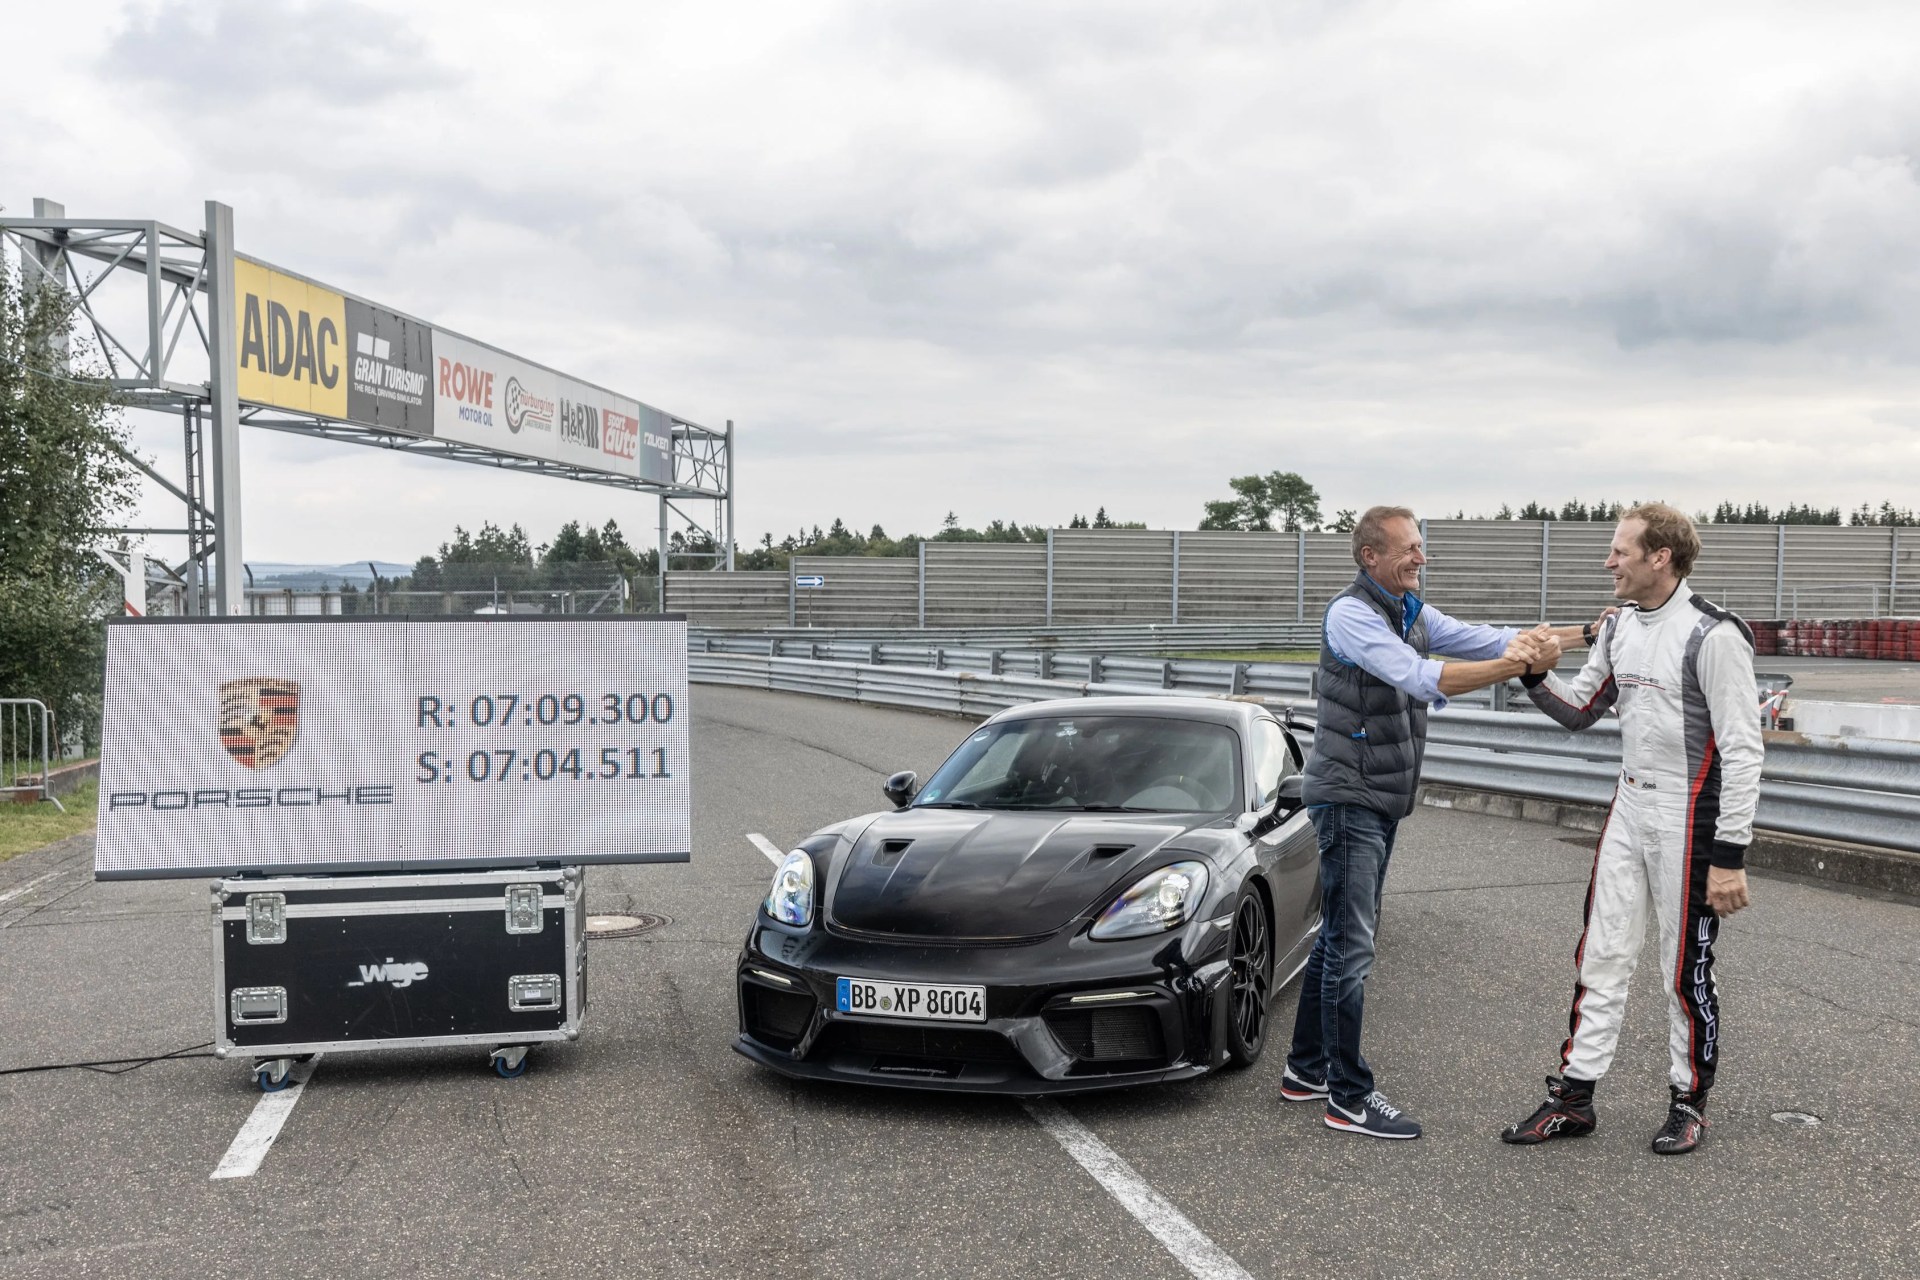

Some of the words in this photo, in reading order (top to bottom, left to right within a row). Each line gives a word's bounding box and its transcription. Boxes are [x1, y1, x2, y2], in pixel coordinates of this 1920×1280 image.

[240, 292, 339, 390] ADAC
[354, 357, 383, 386] GRAN
[384, 364, 425, 397] TURISMO
[354, 382, 364, 393] THE
[364, 385, 377, 396] REAL
[377, 388, 397, 400] DRIVING
[396, 392, 423, 406] SIMULATOR
[438, 356, 494, 409] ROWE
[459, 406, 483, 425] MOTOR
[483, 412, 493, 427] OIL
[560, 397, 586, 447] H&R
[604, 428, 638, 457] auto
[643, 431, 669, 452] FALKEN
[417, 695, 456, 728] R:
[471, 692, 674, 728] 07:09.300
[416, 750, 452, 784] S:
[466, 746, 673, 783] 07:04.511
[108, 785, 394, 812] PORSCHE
[1641, 781, 1657, 790] JÖRG
[851, 984, 877, 1009] BB
[894, 987, 920, 1013] XP
[926, 989, 982, 1016] 8004
[1693, 915, 1718, 1062] PORSCHE
